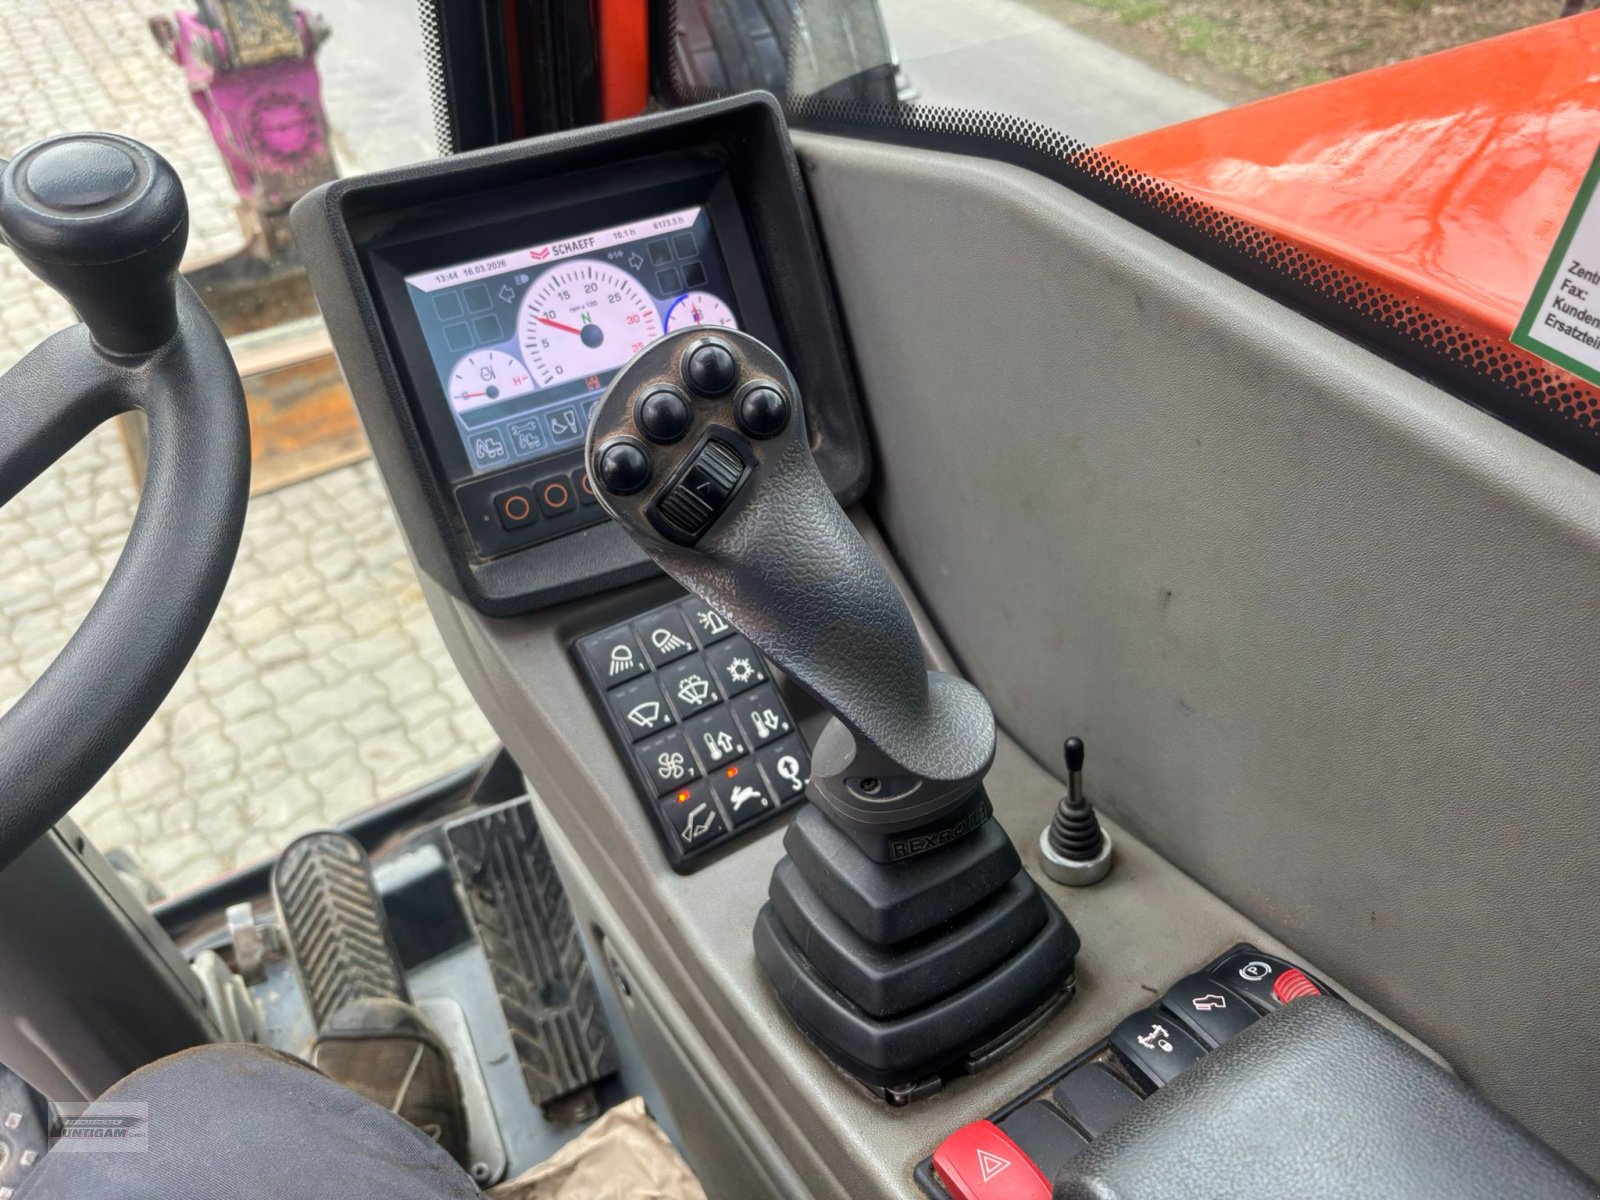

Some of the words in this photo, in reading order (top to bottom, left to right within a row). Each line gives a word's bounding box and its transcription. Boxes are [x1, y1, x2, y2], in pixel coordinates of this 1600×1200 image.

[552, 237, 596, 257] SCHAEFF
[435, 271, 459, 283] 13:44
[463, 259, 507, 277] 16.03.2026
[584, 282, 599, 294] 20
[1560, 278, 1589, 301] Fax:
[557, 290, 571, 301] 15
[608, 293, 622, 304] 25
[543, 310, 557, 320] 10
[581, 311, 592, 325] N
[626, 314, 640, 325] 30
[541, 338, 550, 349] 5
[555, 365, 564, 375] 0
[513, 376, 522, 386] H
